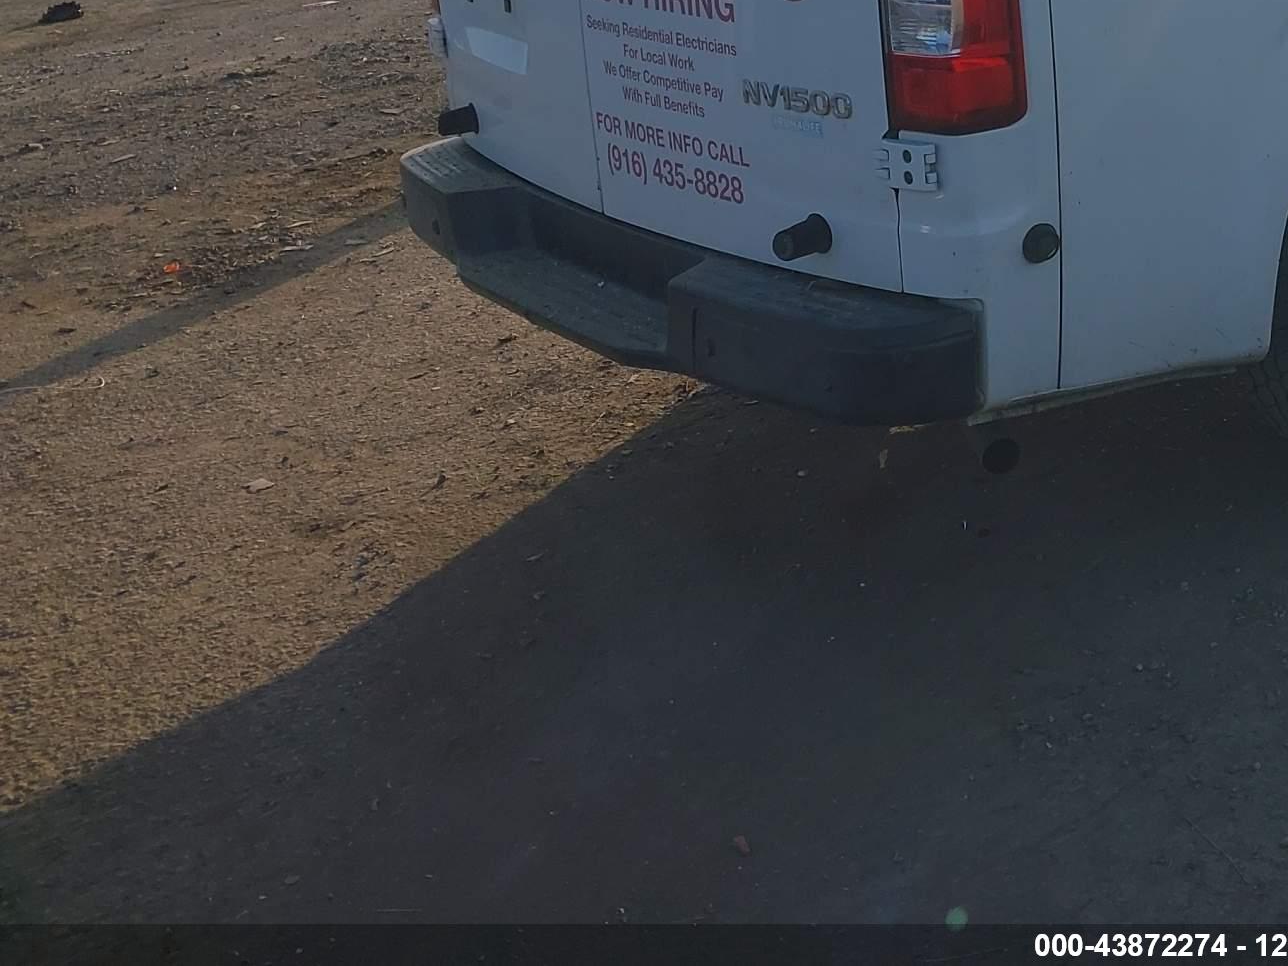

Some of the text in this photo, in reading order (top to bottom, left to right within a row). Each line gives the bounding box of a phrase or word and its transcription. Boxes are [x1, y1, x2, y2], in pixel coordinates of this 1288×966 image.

[586, 14, 737, 57] Seeking Residential Electricians
[623, 44, 696, 72] For Local Work
[603, 60, 724, 103] We Offer Competitive Pay
[622, 86, 705, 118] With Full Benefits
[742, 79, 853, 119] NV1500
[596, 111, 750, 168] FOR MORE INFO CALL
[607, 142, 744, 205] (916) 435-8828
